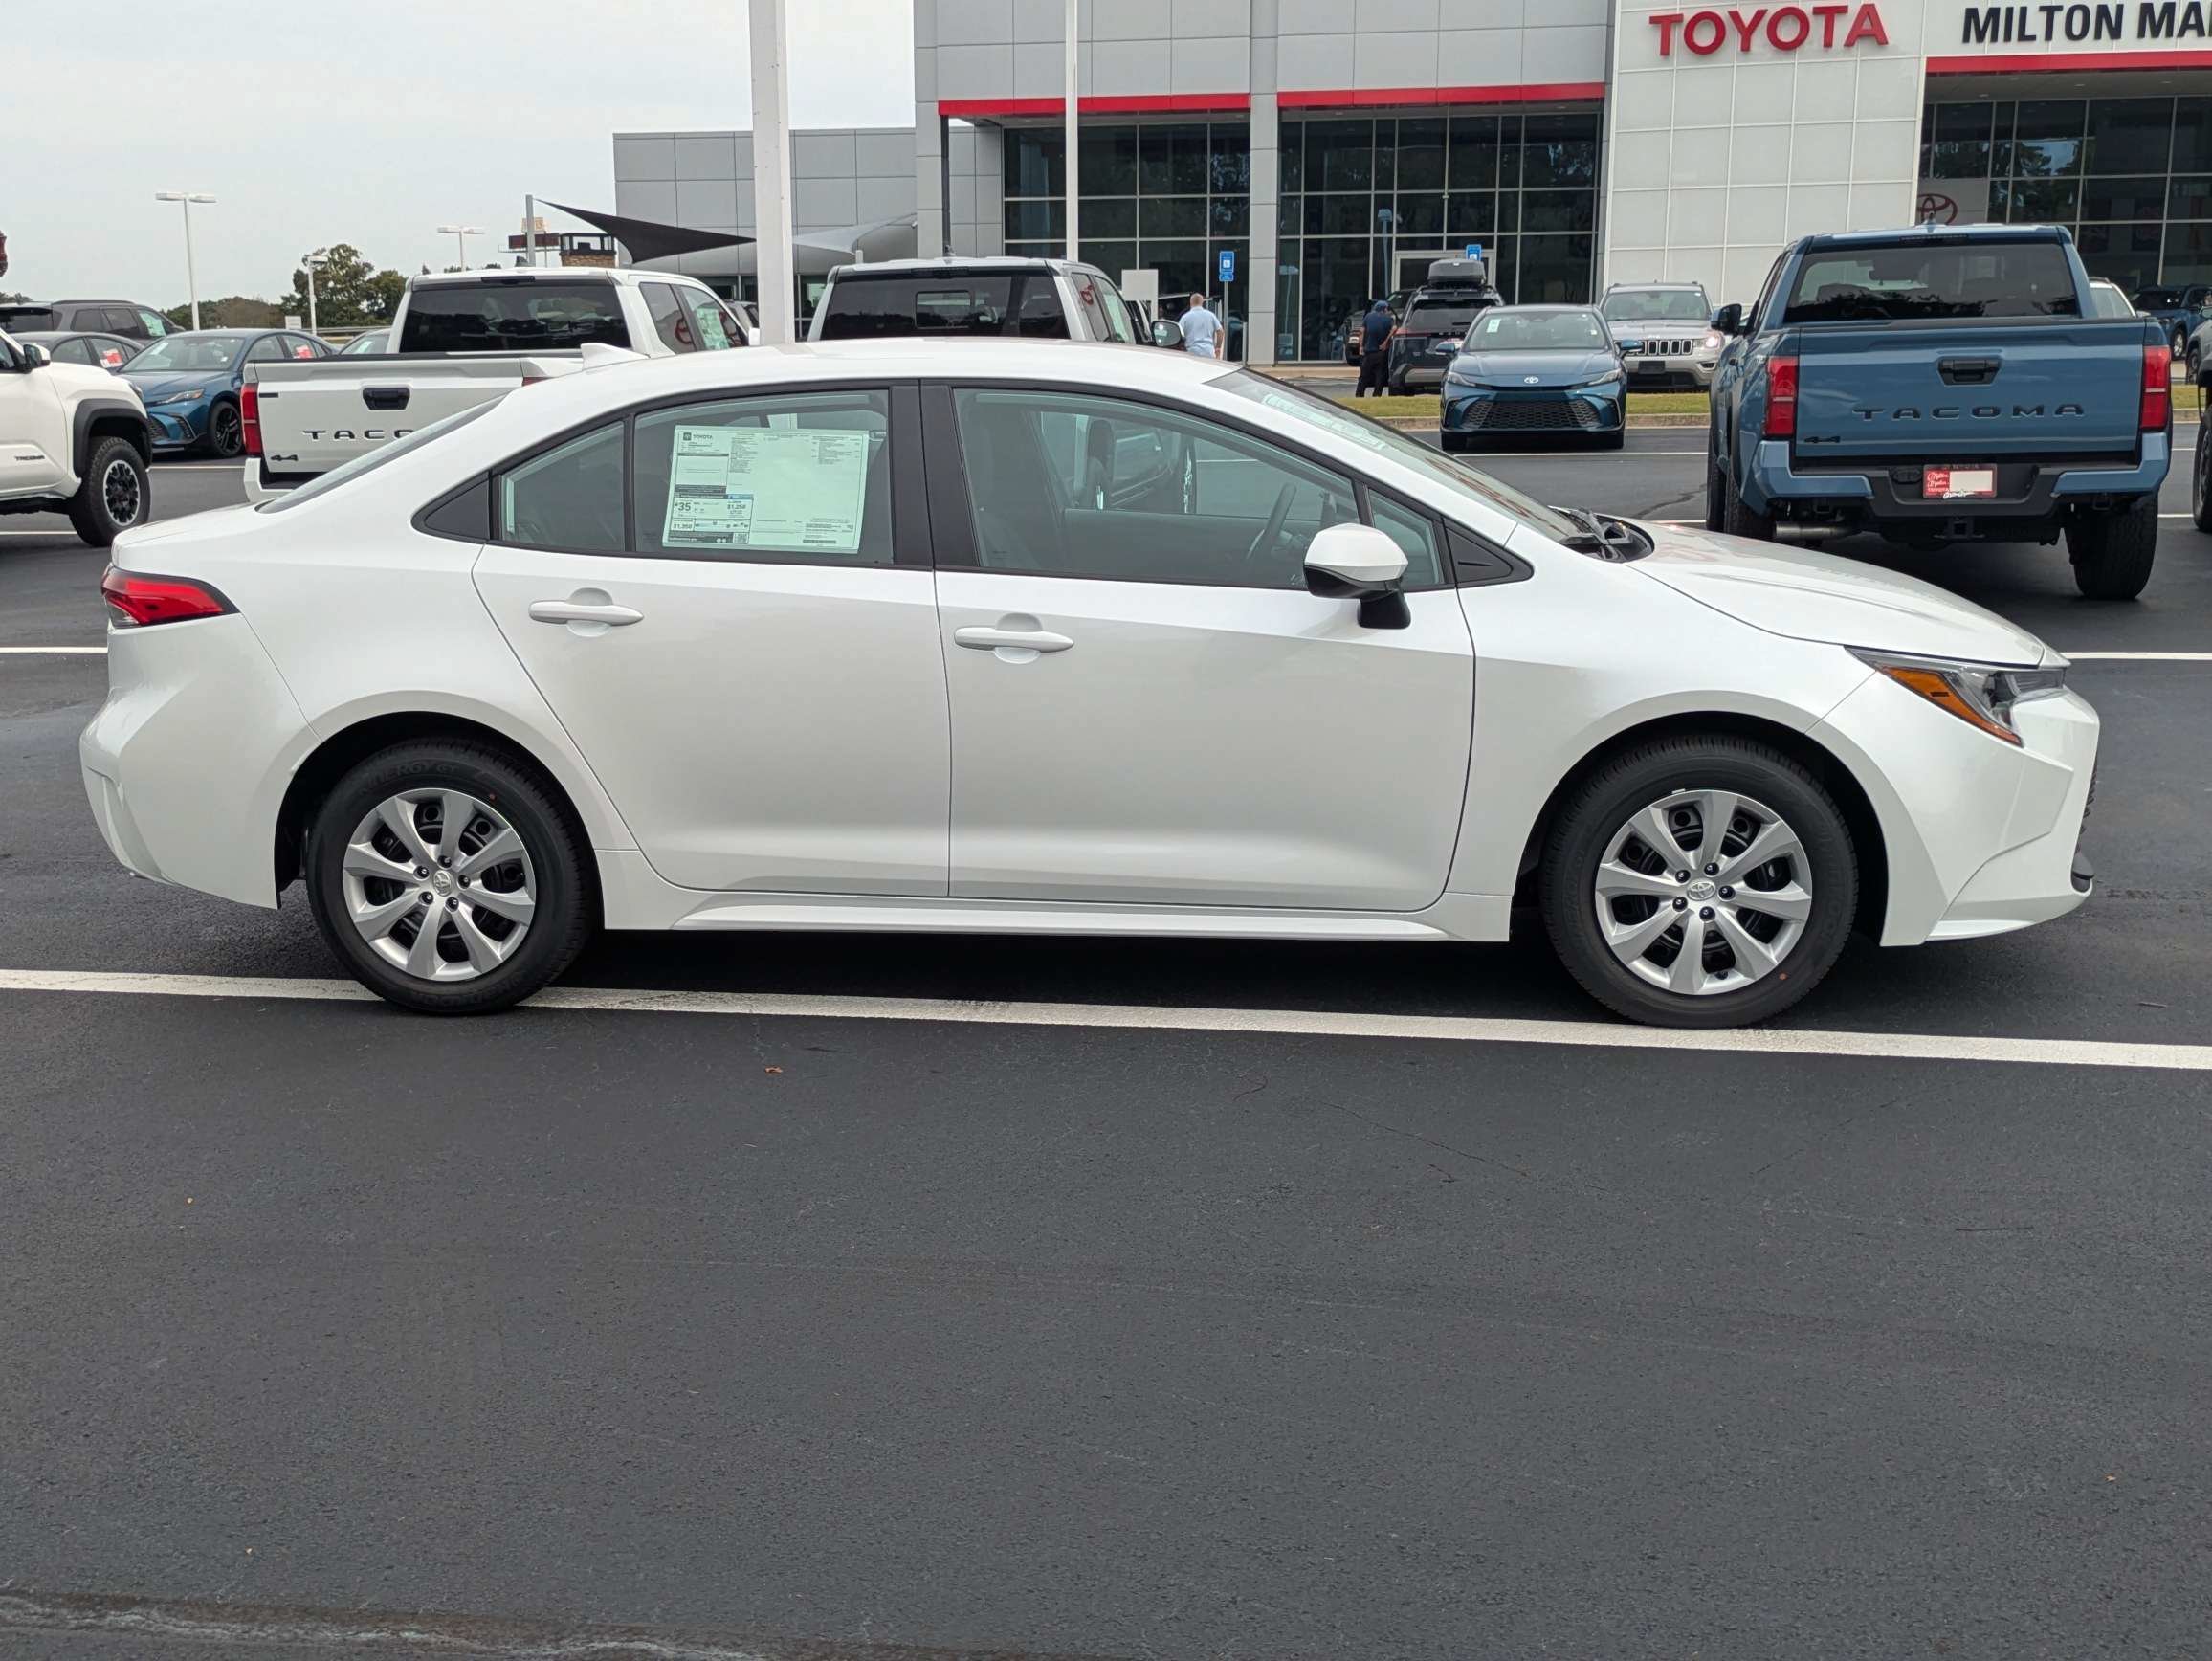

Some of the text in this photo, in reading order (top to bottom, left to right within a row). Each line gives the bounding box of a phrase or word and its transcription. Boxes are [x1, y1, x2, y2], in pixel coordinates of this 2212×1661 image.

[1648, 3, 1889, 56] TOYOTA
[1962, 1, 2212, 43] MILTON MA
[1851, 403, 2085, 421] TACOMA
[677, 502, 691, 512] 35
